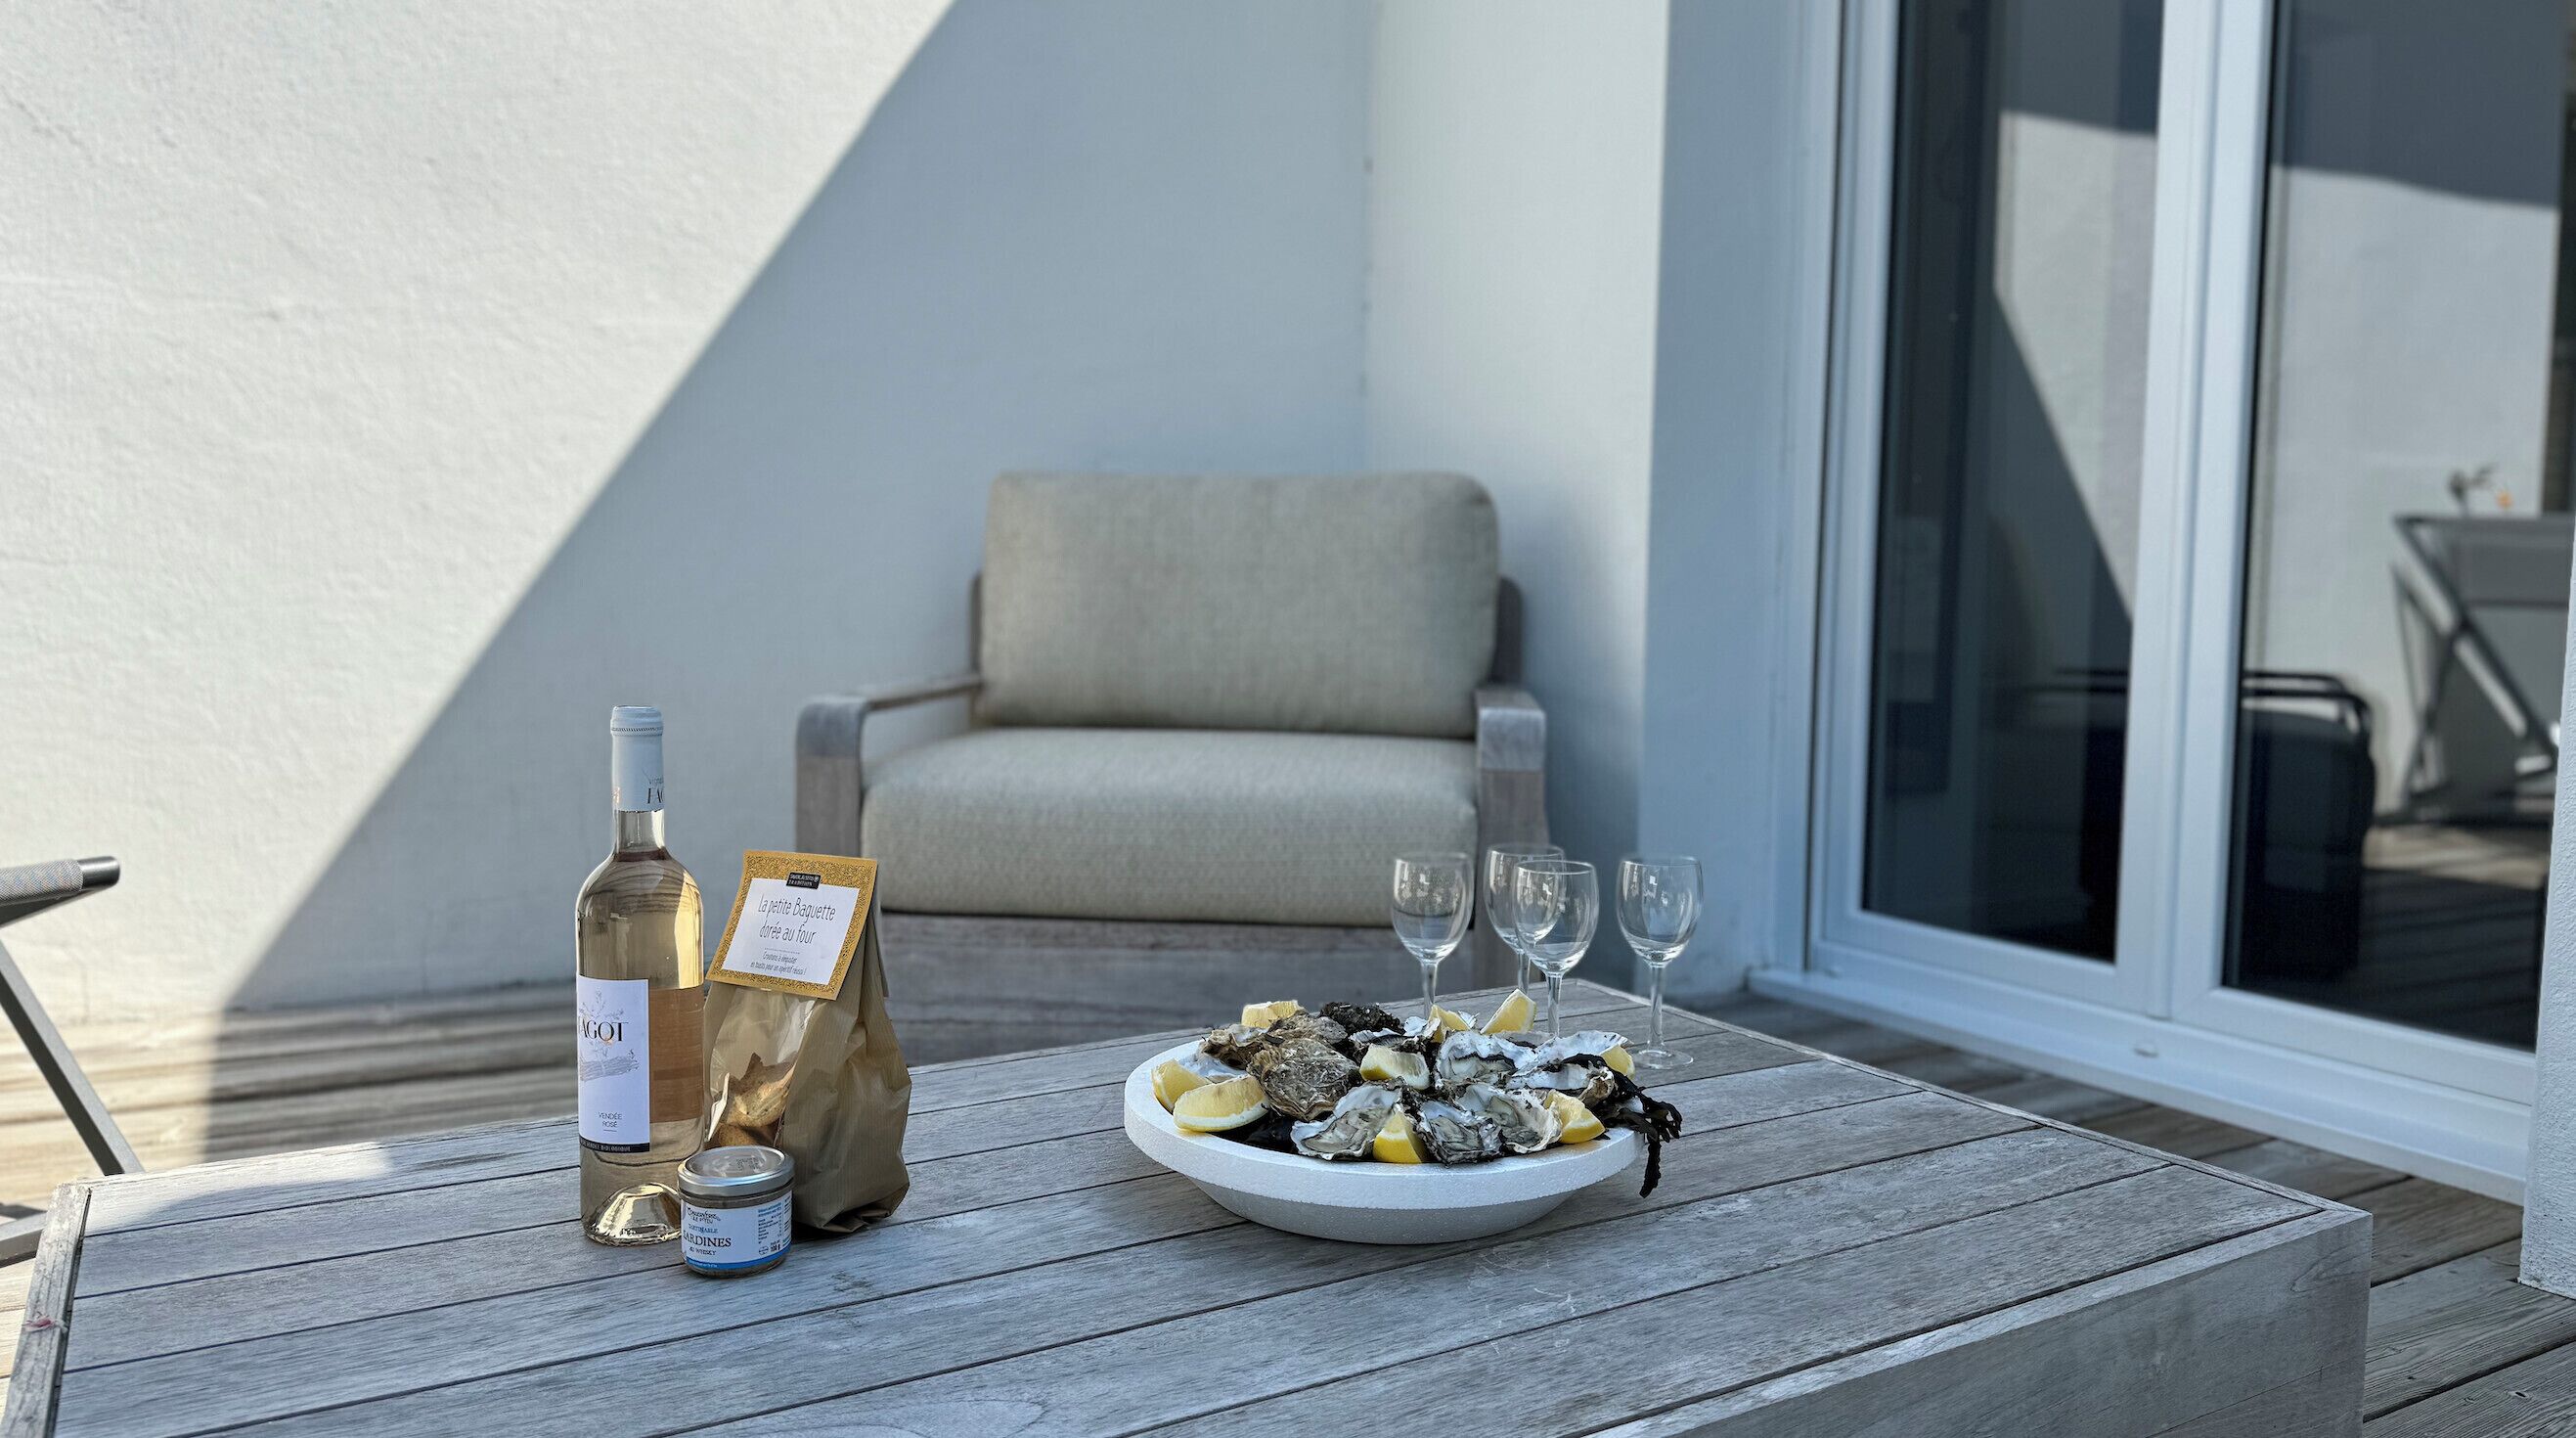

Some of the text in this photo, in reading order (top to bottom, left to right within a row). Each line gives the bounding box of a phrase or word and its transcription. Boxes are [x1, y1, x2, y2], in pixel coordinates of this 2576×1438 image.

[758, 893, 836, 923] La petite Baguette
[759, 920, 817, 944] dorée au four
[598, 1111, 623, 1120] VENDÉE
